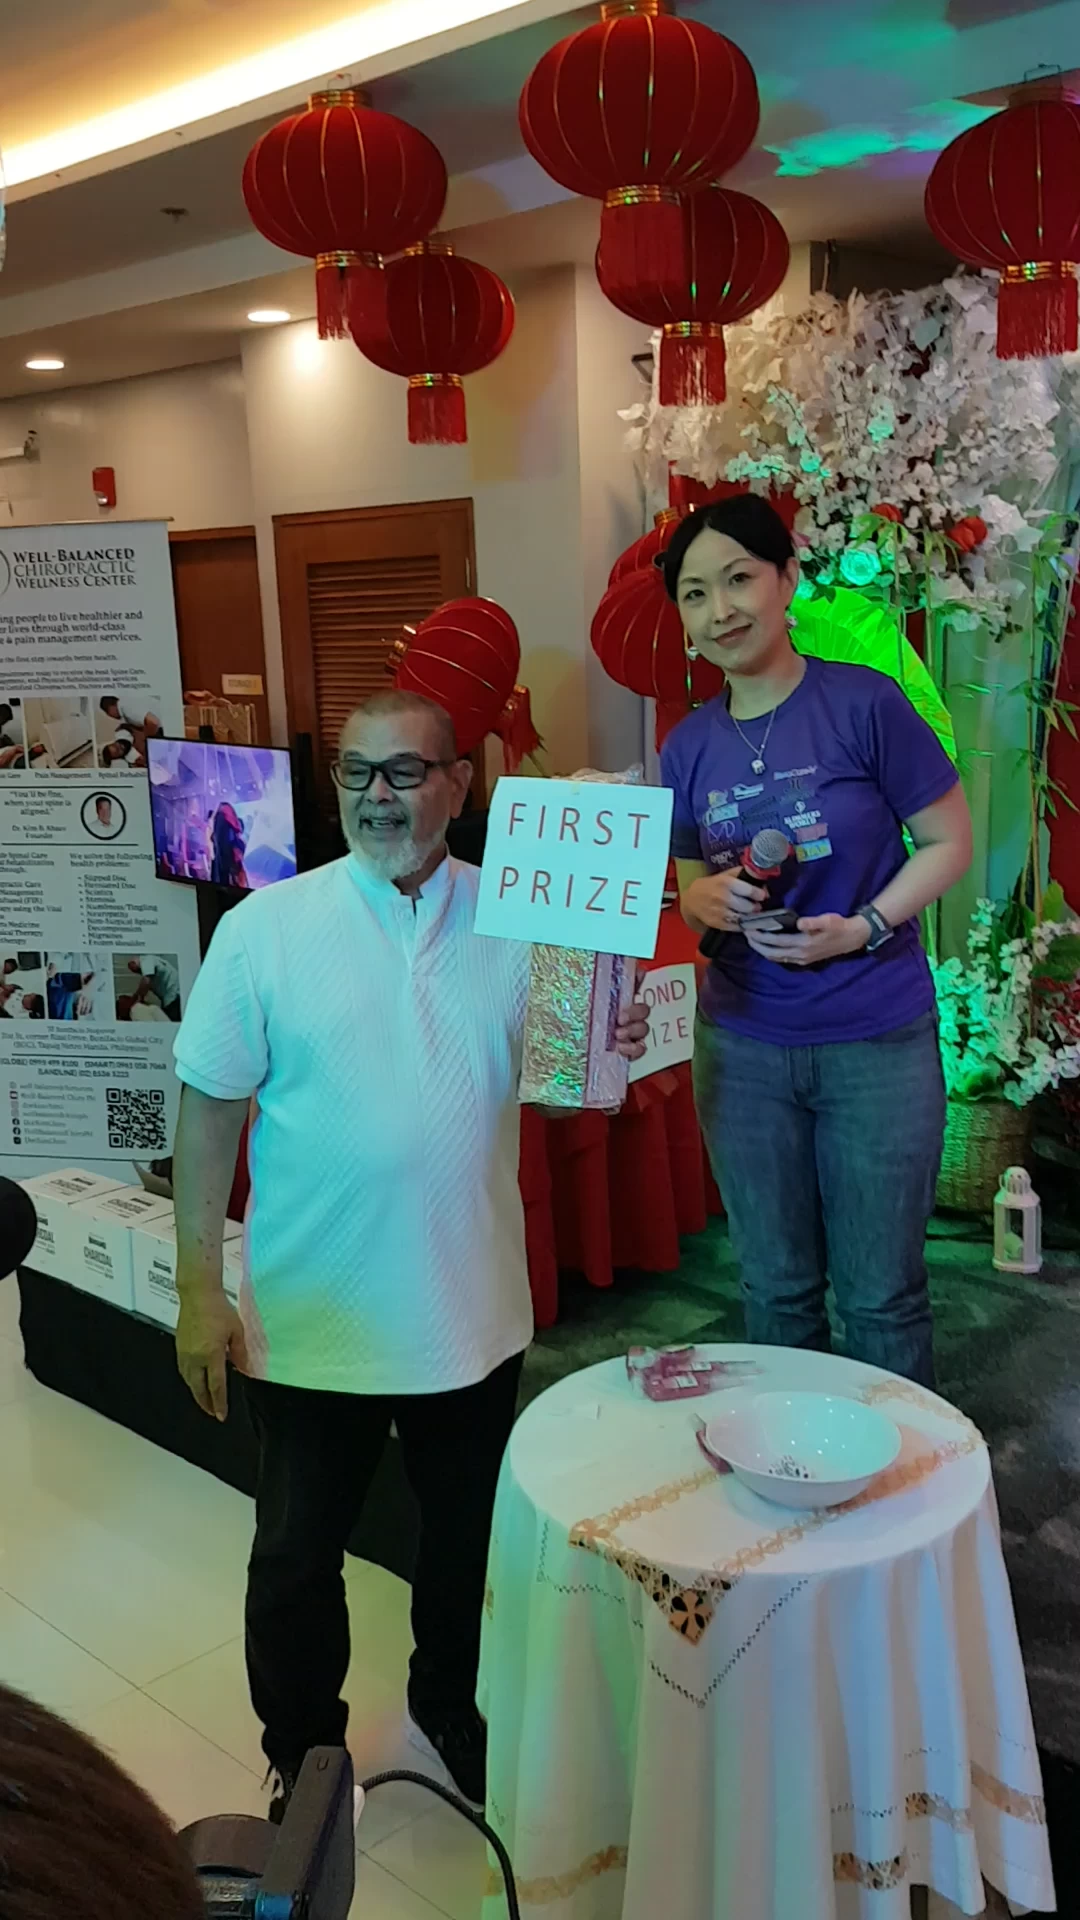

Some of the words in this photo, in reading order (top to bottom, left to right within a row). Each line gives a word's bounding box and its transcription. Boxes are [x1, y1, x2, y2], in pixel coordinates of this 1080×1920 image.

[13, 548, 135, 563] WELL-BALANCED
[14, 560, 136, 577] CHIROPRACTIC
[15, 576, 80, 589] WELLNESS
[83, 574, 137, 588] CENTER
[16, 613, 46, 624] people
[48, 614, 57, 622] to
[60, 612, 78, 621] live
[79, 611, 122, 621] healthier
[124, 610, 143, 620] and
[8, 625, 30, 634] lives
[31, 623, 69, 634] through
[71, 622, 126, 632] world-class
[15, 635, 36, 646] pain
[38, 634, 98, 645] management
[99, 632, 142, 642] services.
[509, 802, 650, 849] FIRST
[498, 866, 642, 916] PRIZE
[651, 1016, 689, 1048] IZE
